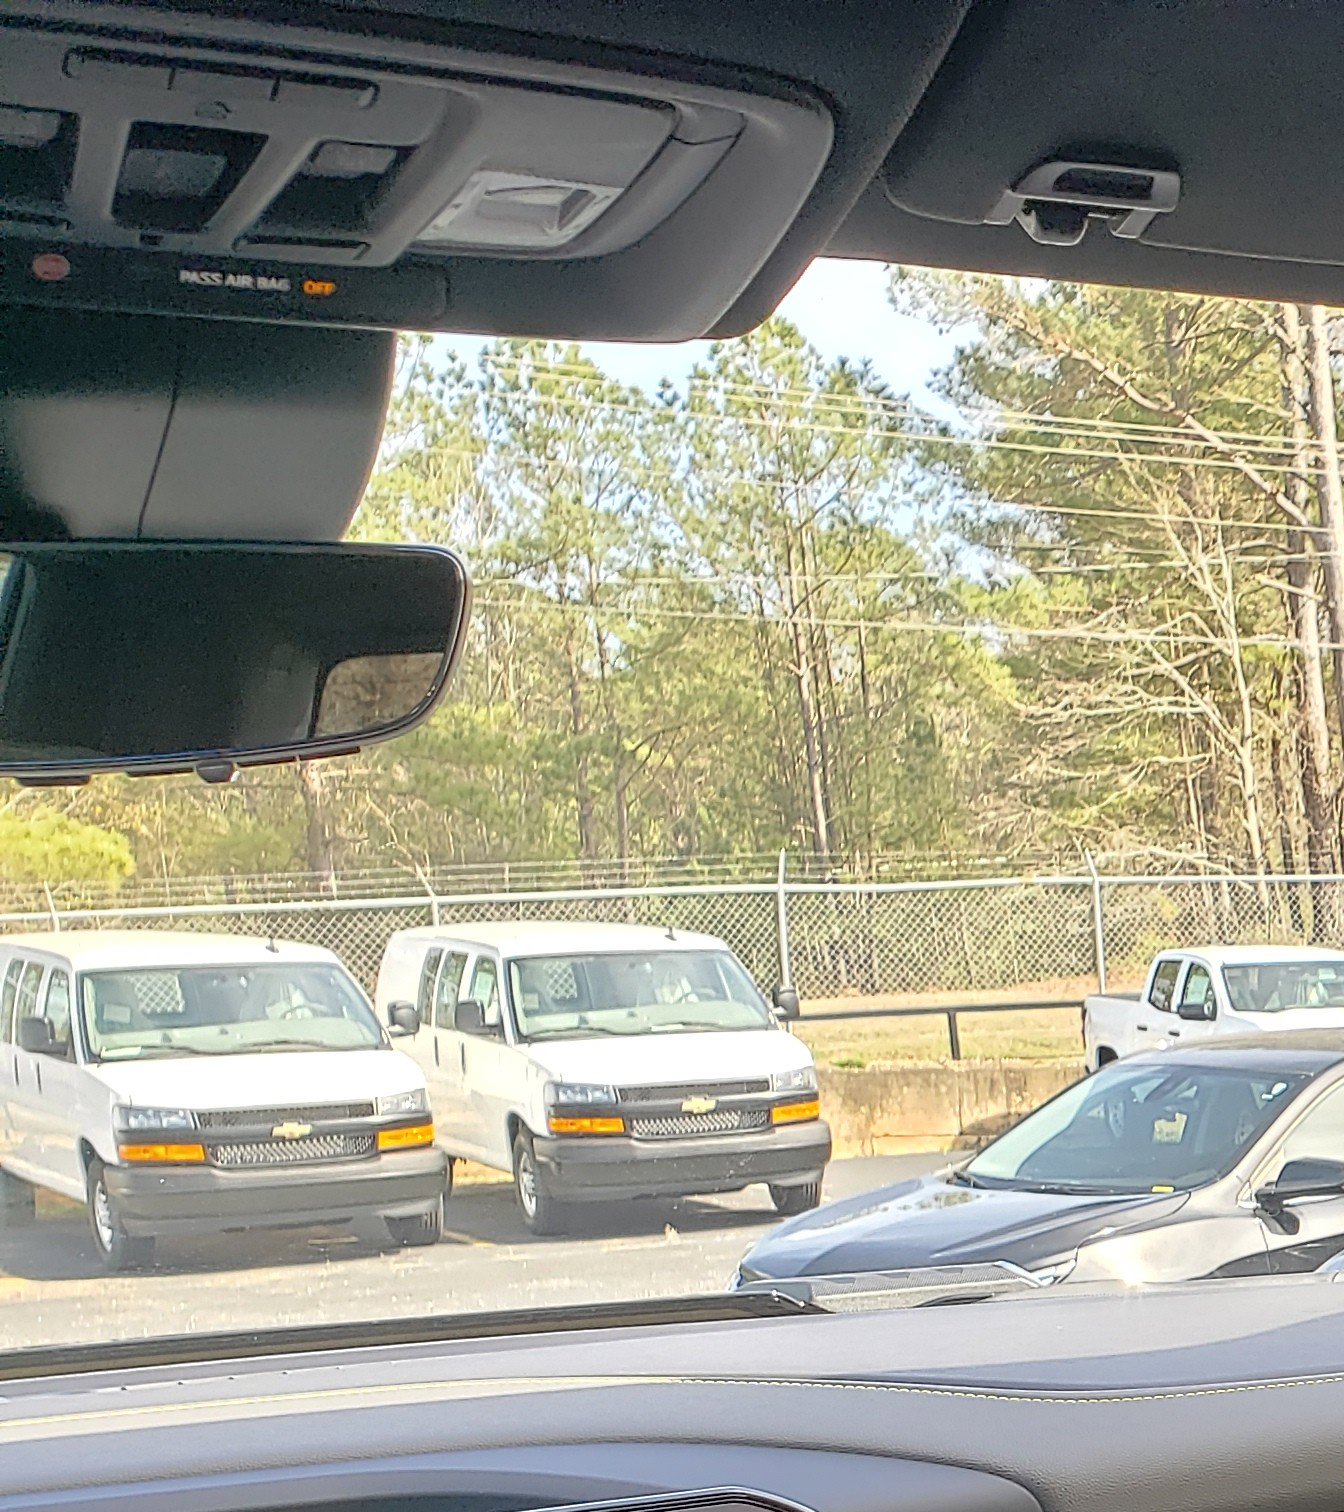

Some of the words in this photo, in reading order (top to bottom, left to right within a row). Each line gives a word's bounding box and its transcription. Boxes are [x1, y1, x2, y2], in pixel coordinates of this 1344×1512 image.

[180, 269, 223, 286] PASS
[224, 273, 253, 289] AIR
[256, 275, 292, 292] BAG
[303, 279, 336, 295] OFF
